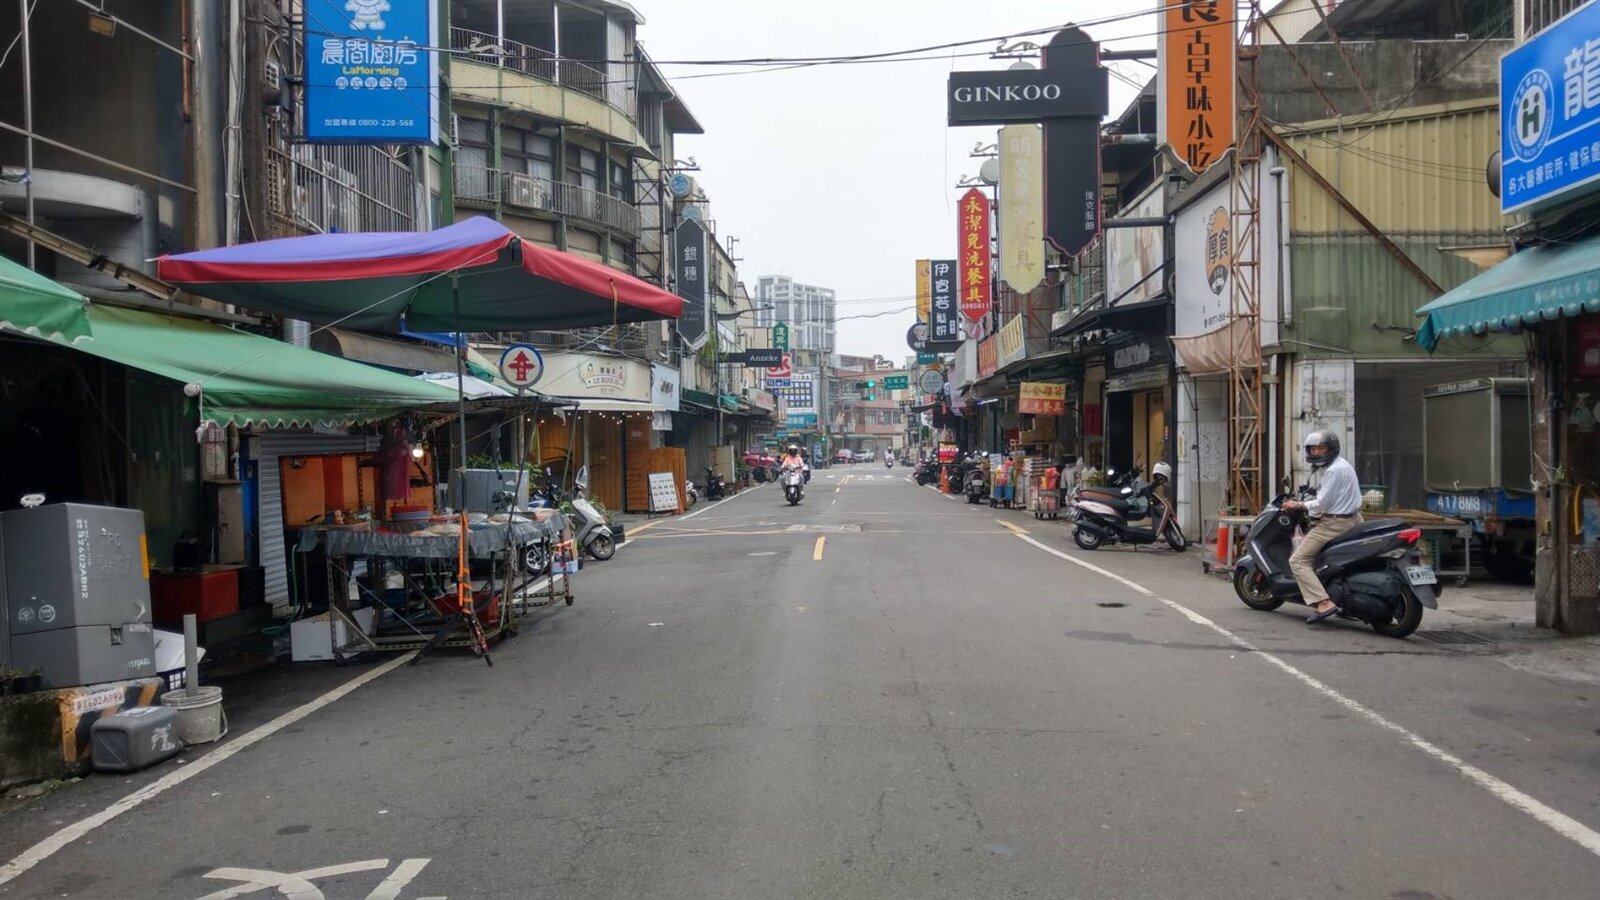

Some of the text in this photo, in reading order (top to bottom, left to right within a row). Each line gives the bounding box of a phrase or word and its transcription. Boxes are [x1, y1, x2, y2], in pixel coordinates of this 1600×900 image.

[321, 37, 417, 65] 晨間廚房
[342, 66, 399, 76] LaMorning
[954, 84, 1061, 103] GINKOO
[1184, 30, 1214, 168] 古早味小吃
[358, 119, 414, 127] 0800-228-568
[965, 196, 984, 302] 永潔免洗餐具
[684, 246, 698, 282] 銀穗
[1438, 495, 1480, 511] 4178M8
